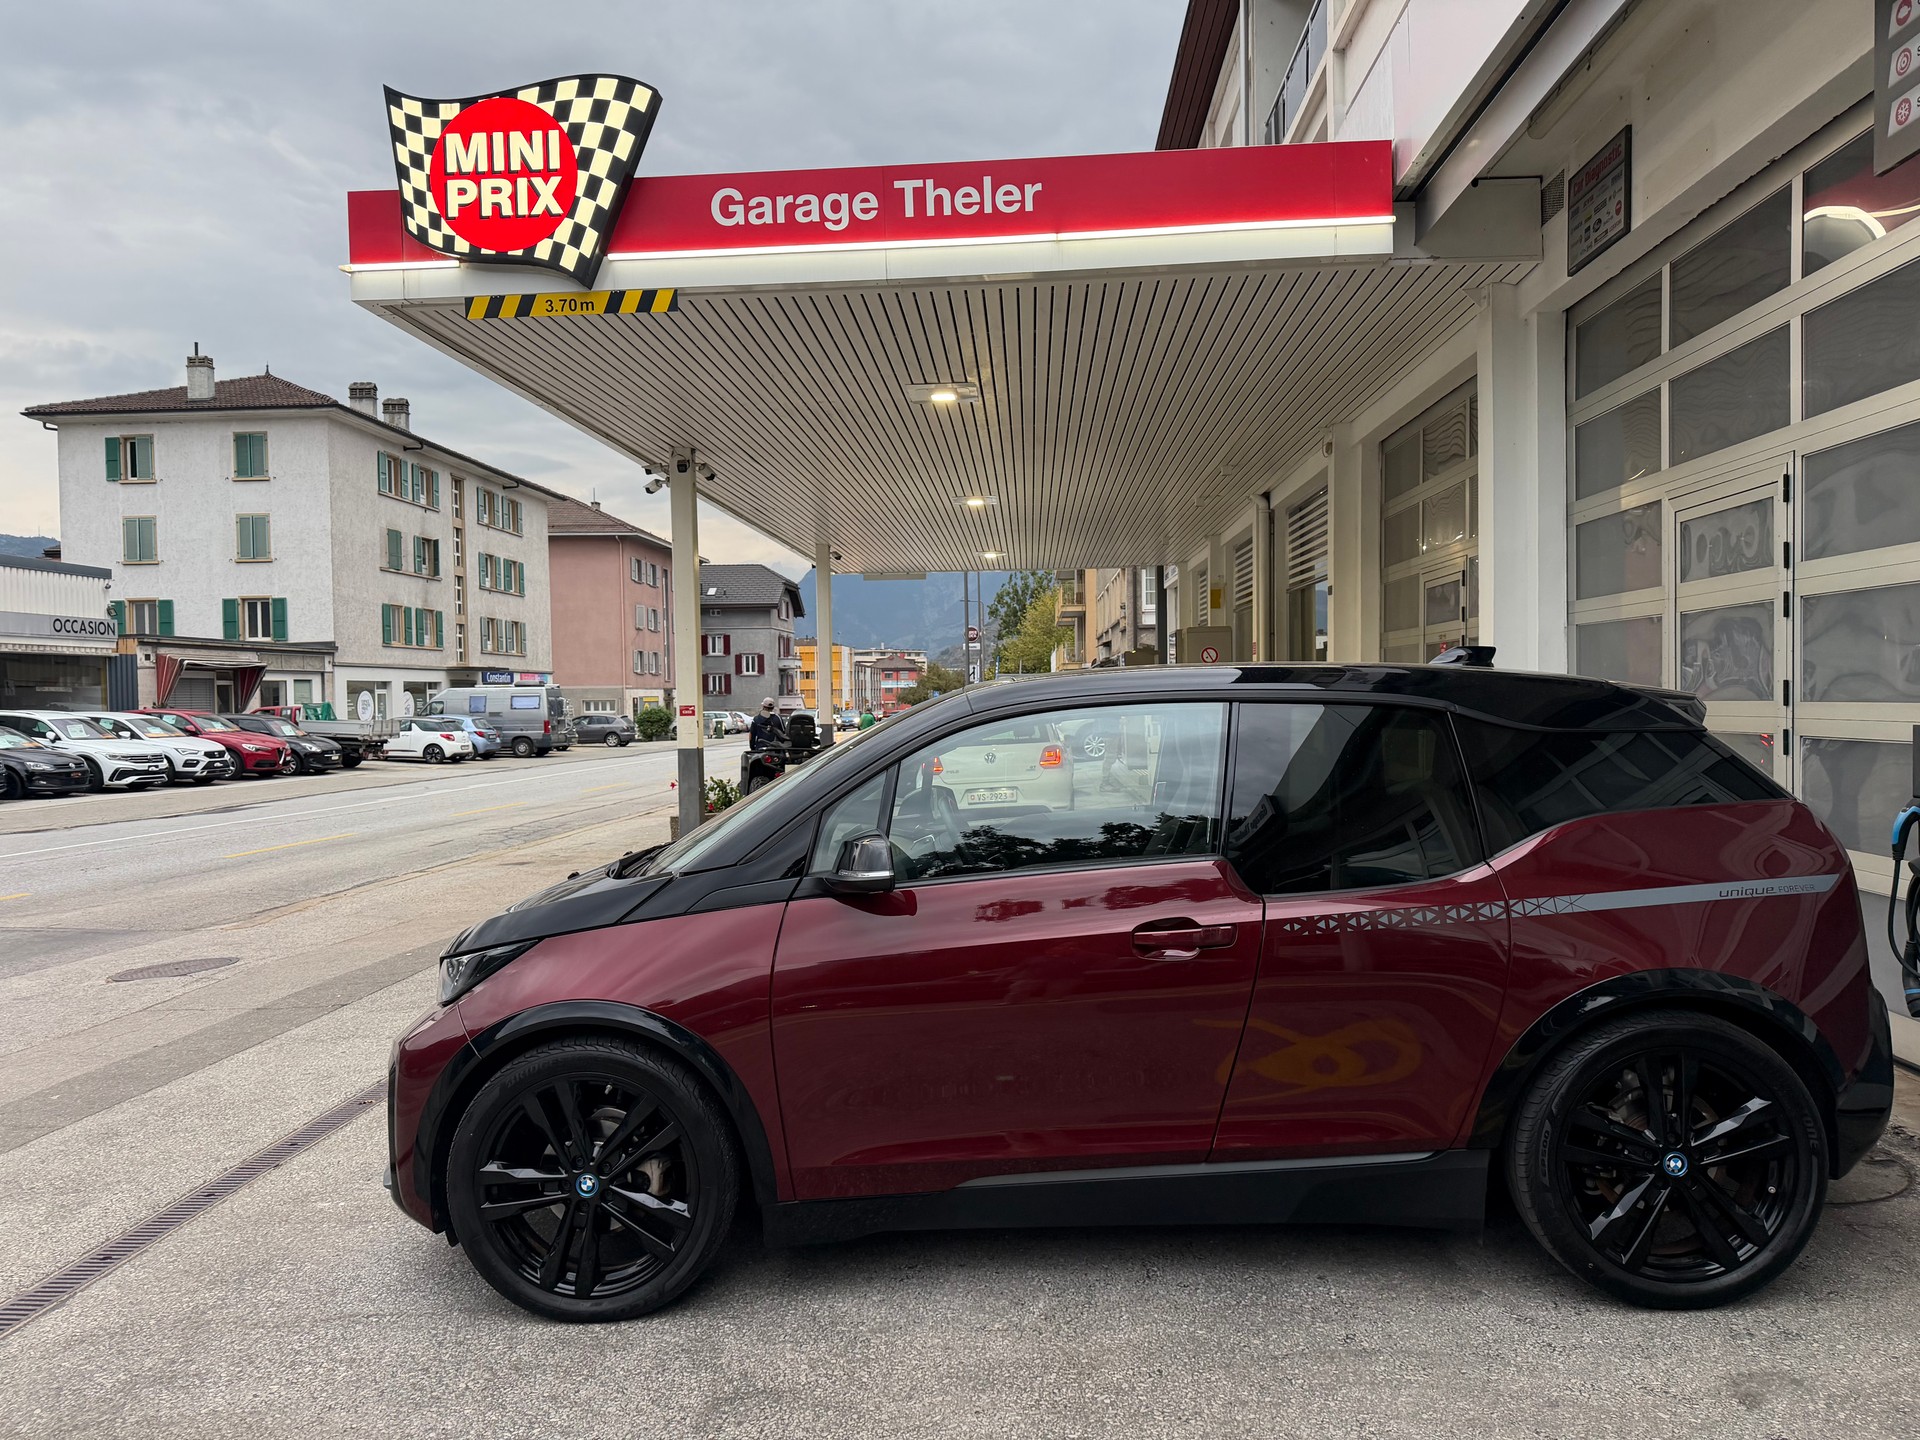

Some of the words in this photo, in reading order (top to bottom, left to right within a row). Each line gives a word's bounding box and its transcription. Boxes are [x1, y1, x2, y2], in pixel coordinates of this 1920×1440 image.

[444, 129, 561, 174] MINI
[1584, 143, 1622, 187] Diagnostic
[446, 176, 564, 219] PRIX
[710, 187, 879, 231] Garage
[893, 175, 1042, 218] Theler
[52, 618, 116, 636] OCCASION
[486, 672, 511, 683] Constantin
[1719, 886, 1776, 898] unique
[1778, 884, 1816, 893] FOREVER
